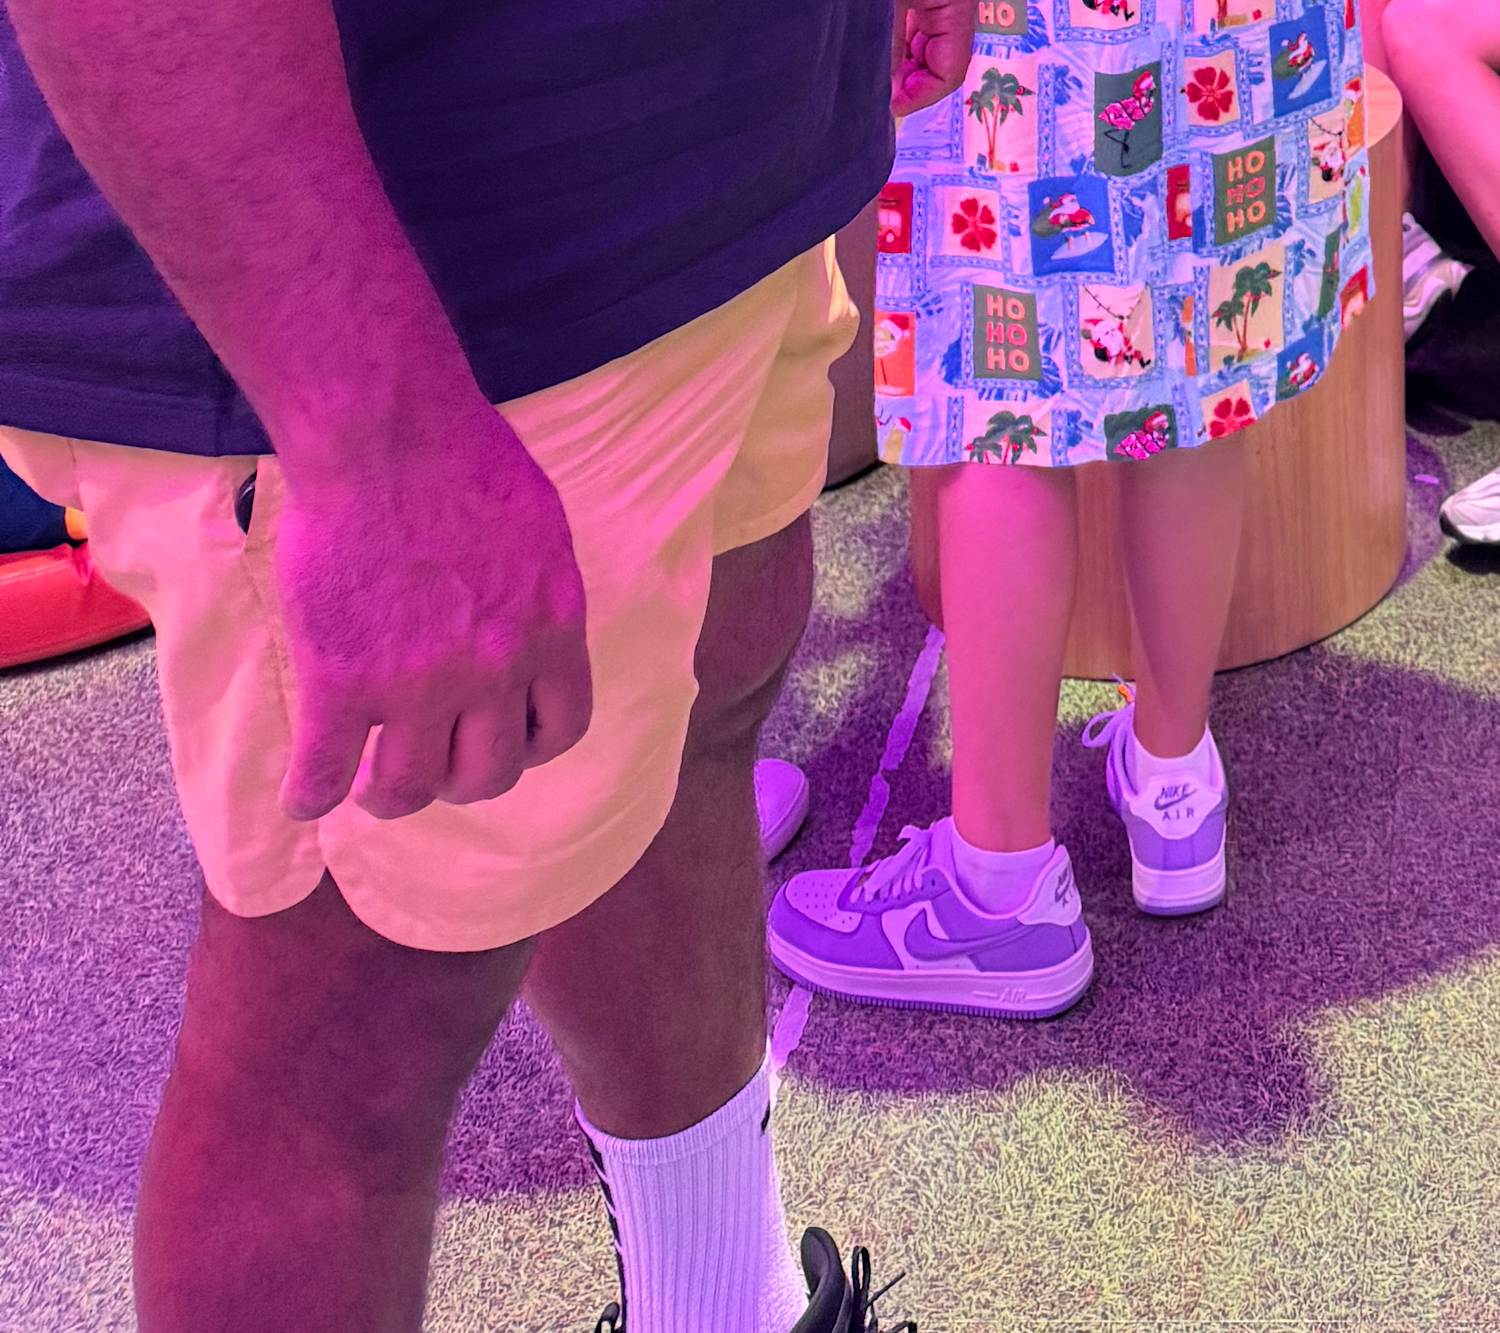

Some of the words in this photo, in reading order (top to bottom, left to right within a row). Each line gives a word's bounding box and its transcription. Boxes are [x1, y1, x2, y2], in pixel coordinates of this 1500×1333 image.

[978, 1, 1016, 27] HO
[1227, 150, 1265, 183] HO
[1226, 176, 1266, 207] HO
[1226, 200, 1266, 234] HO
[986, 293, 1026, 321] HO
[986, 321, 1028, 347] HO
[986, 347, 1030, 372] HO
[1159, 783, 1190, 800] NIKE
[1161, 807, 1195, 821] AIR
